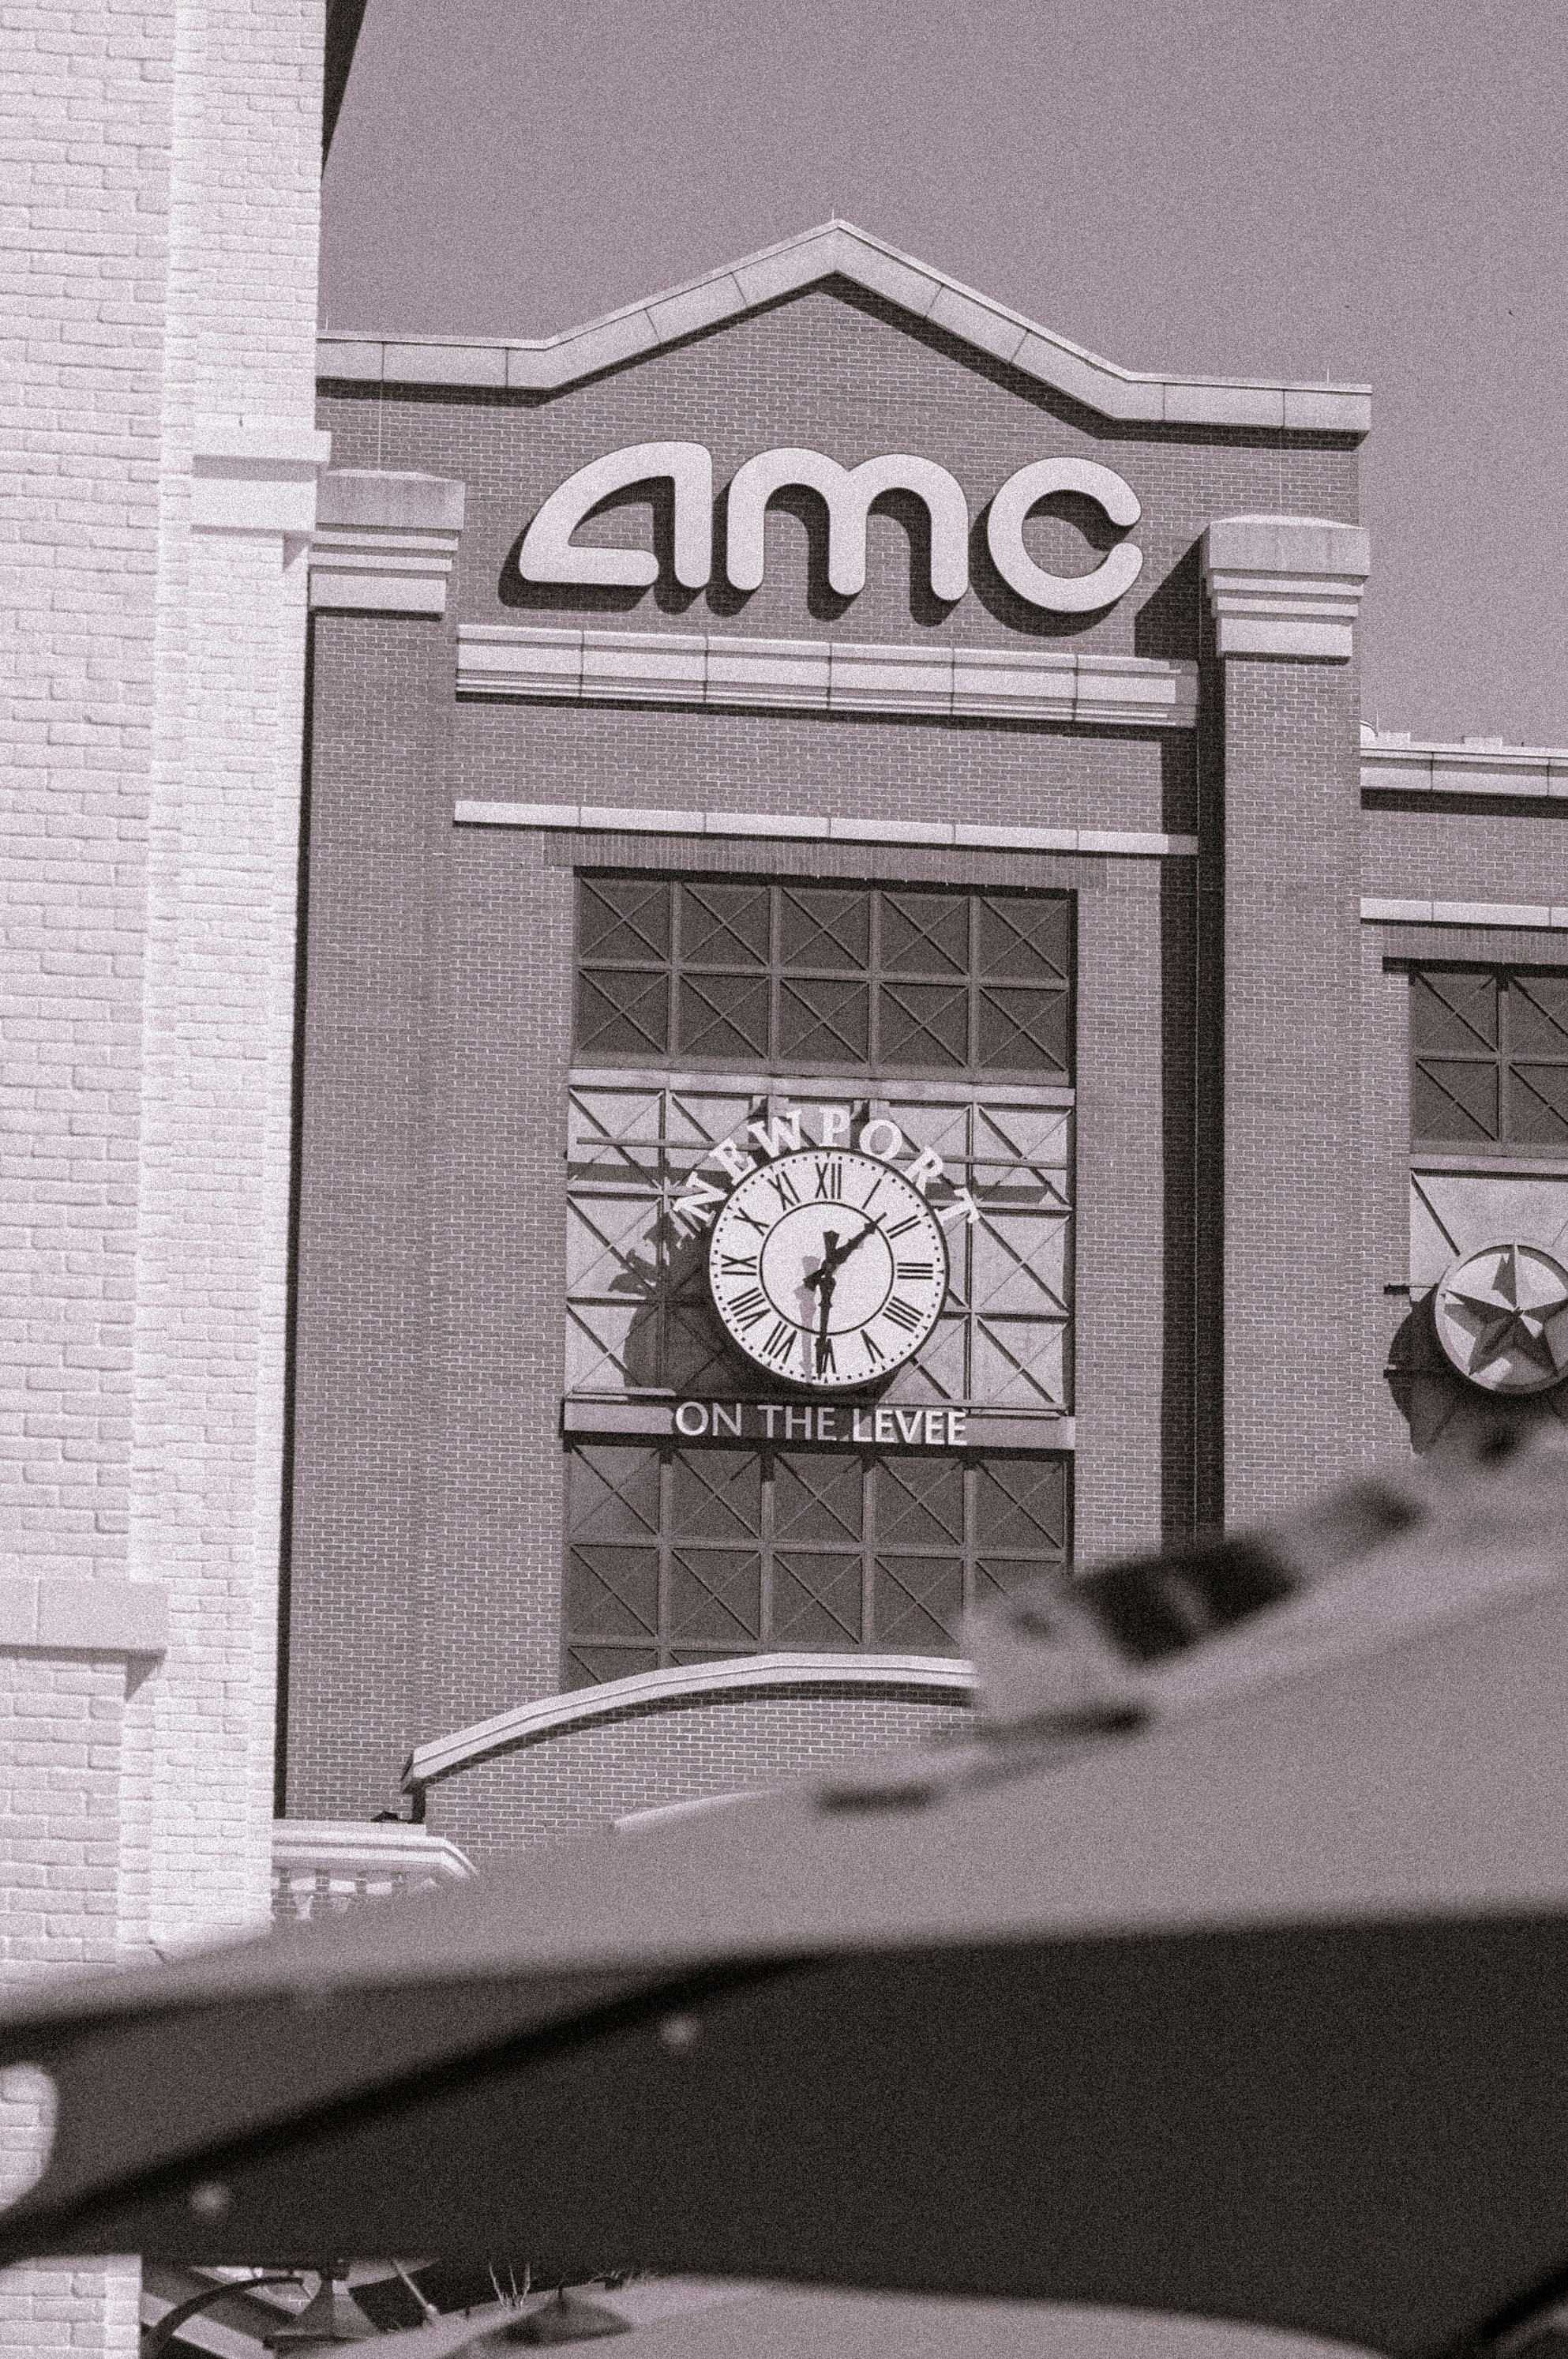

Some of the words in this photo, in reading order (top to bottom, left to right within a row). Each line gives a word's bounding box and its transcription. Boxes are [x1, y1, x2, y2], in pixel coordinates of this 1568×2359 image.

[673, 1106, 980, 1226] NEWPORT
[815, 1163, 842, 1199] XII
[767, 1170, 801, 1211] XI
[675, 1402, 741, 1436] ON
[757, 1405, 835, 1441] THE
[853, 1408, 967, 1446] LEVEE
